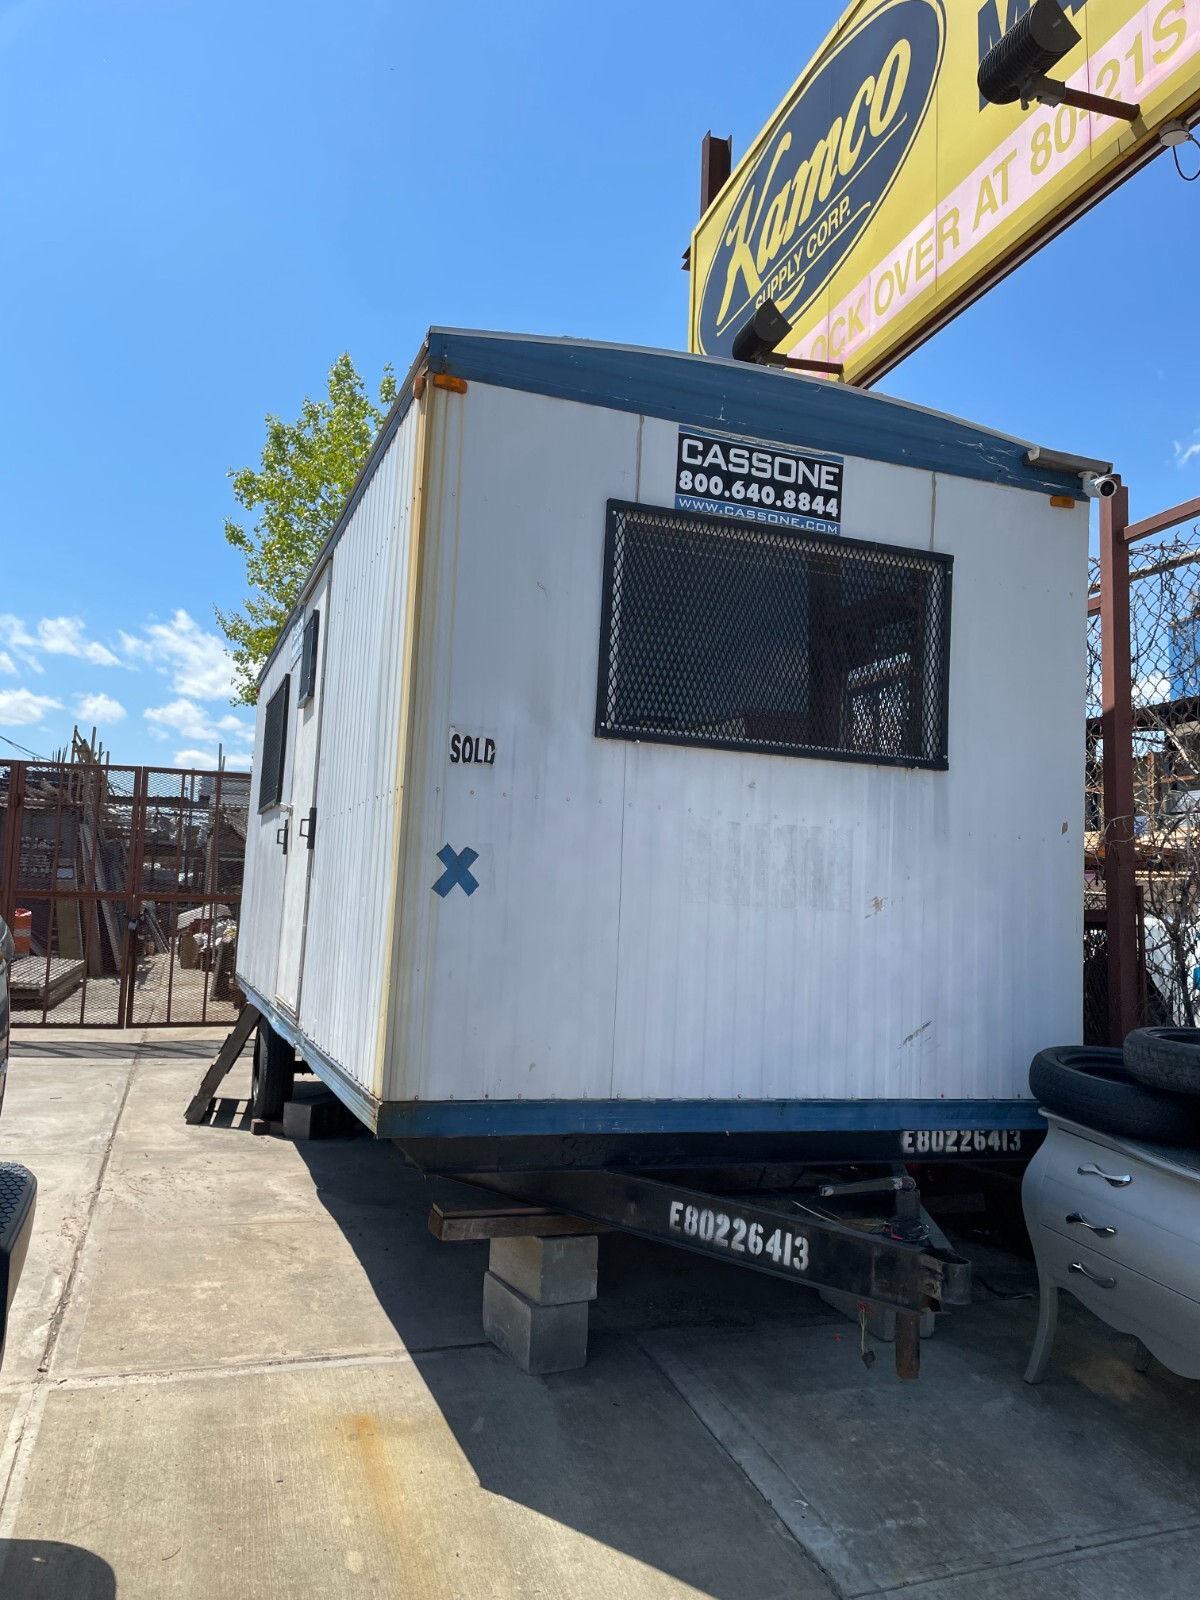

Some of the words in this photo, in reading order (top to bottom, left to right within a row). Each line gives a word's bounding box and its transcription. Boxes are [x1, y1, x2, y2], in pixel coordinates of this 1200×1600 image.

[717, 38, 911, 326] Kamco
[755, 246, 803, 310] SUPPLY
[806, 195, 851, 259] CORP.
[874, 206, 960, 316] OVER
[972, 148, 1018, 232] AT
[682, 438, 839, 491] CASSONE
[679, 470, 838, 517] 800.640.8844
[679, 498, 838, 534] WWW.CASSONE.COM
[450, 733, 496, 764] SOLD
[902, 1130, 1021, 1153] E80226413
[669, 1201, 809, 1271] E80226413
